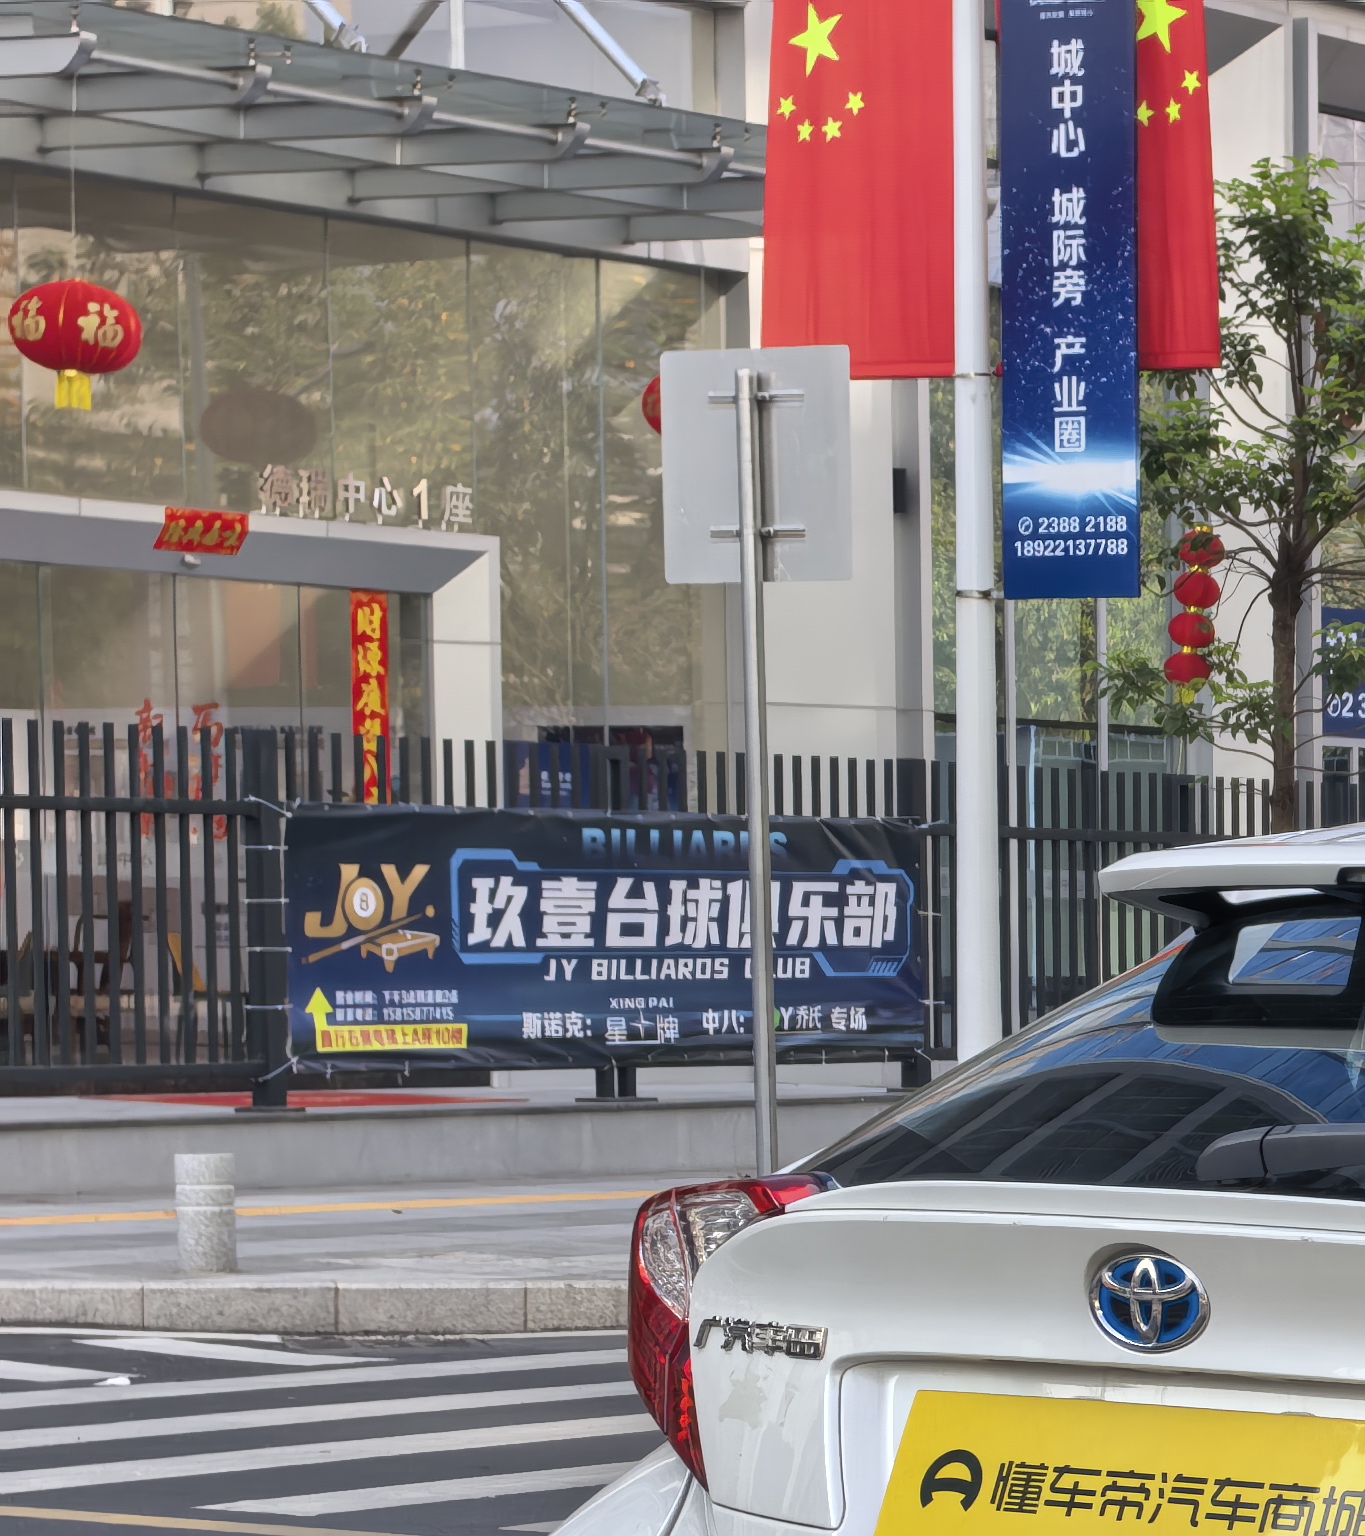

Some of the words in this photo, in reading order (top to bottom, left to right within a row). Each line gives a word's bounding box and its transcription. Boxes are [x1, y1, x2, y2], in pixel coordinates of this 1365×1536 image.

[1050, 38, 1086, 158] 城中心
[1051, 186, 1087, 308] 城际旁
[12, 296, 46, 341] 福
[77, 302, 124, 348] 福
[1053, 335, 1087, 453] 产业圈
[1038, 517, 1080, 533] 2388
[1085, 515, 1127, 532] 2188
[1014, 538, 1128, 557] 18922137788
[304, 863, 431, 938] JOY
[544, 957, 577, 981] JY
[591, 957, 729, 981] BILLIARDS
[744, 957, 811, 979] UB
[831, 1006, 867, 1032] 专场
